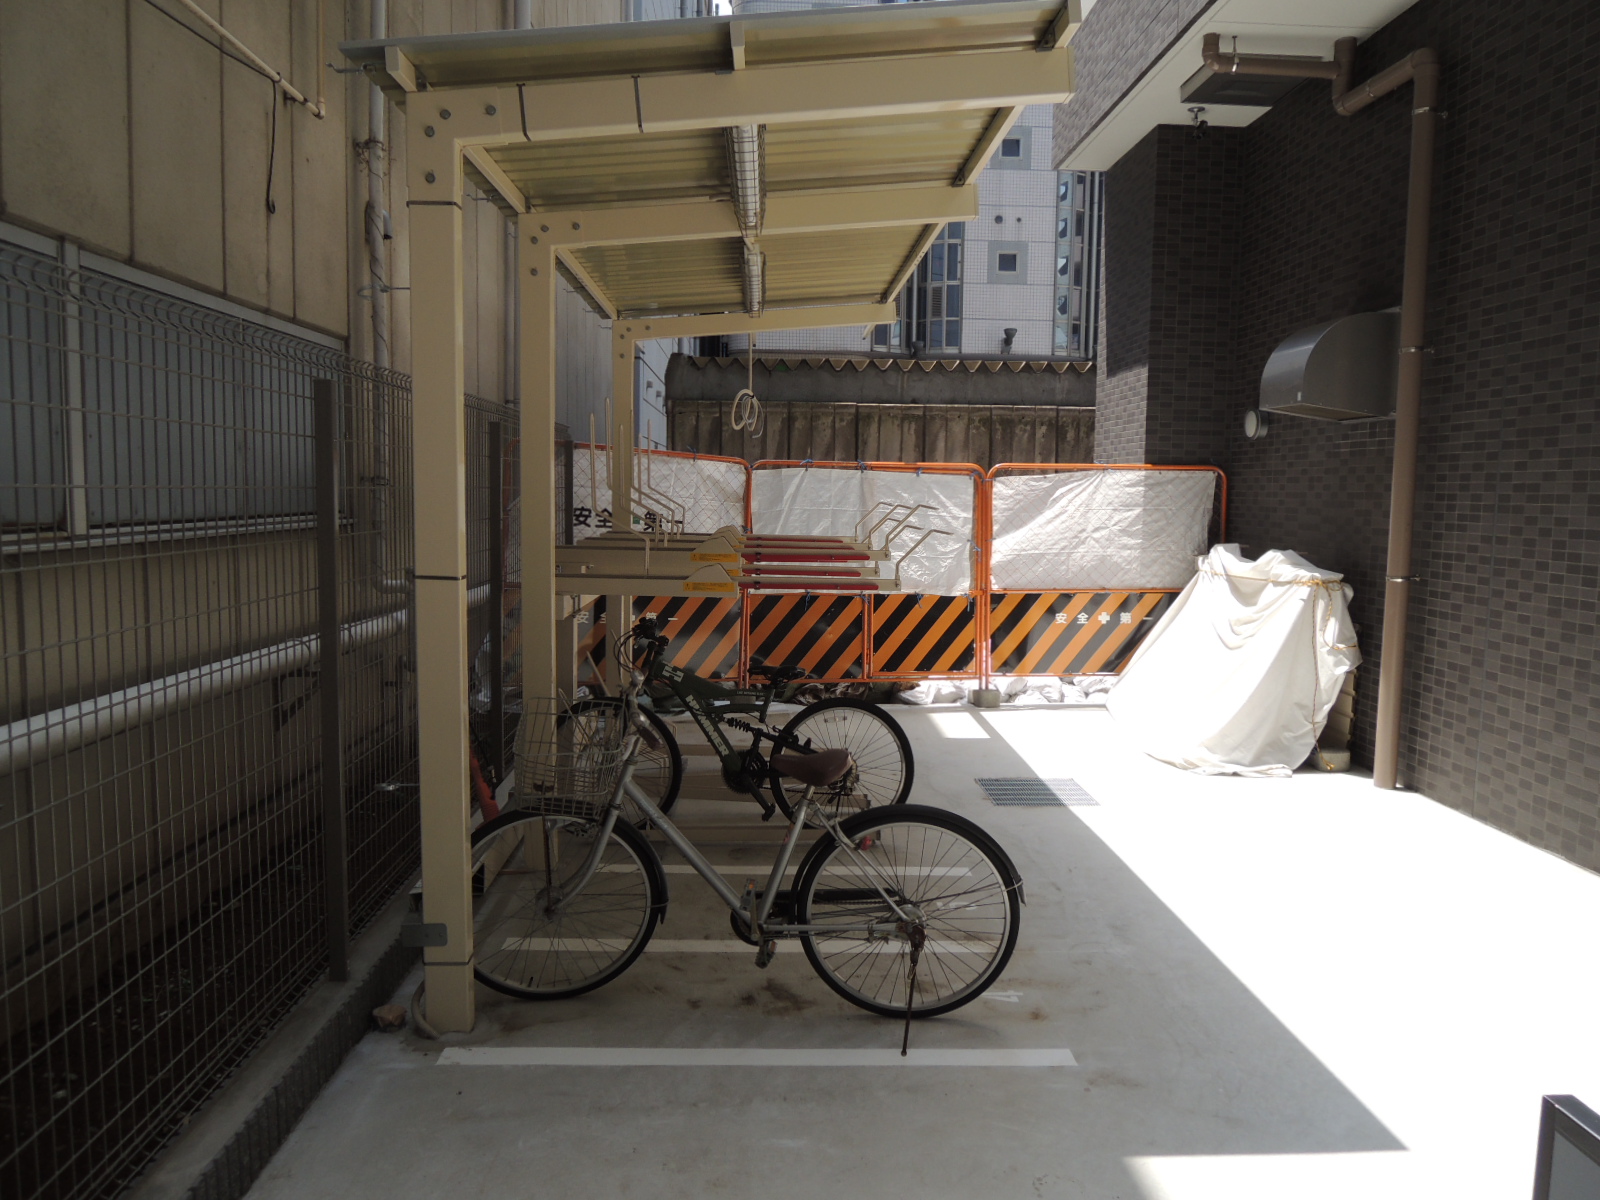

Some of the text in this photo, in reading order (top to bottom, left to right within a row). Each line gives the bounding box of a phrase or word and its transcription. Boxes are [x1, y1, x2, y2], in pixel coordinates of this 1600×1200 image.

[573, 506, 612, 528] 安全
[1055, 612, 1089, 624] 安全
[685, 694, 730, 757] HUMMER
